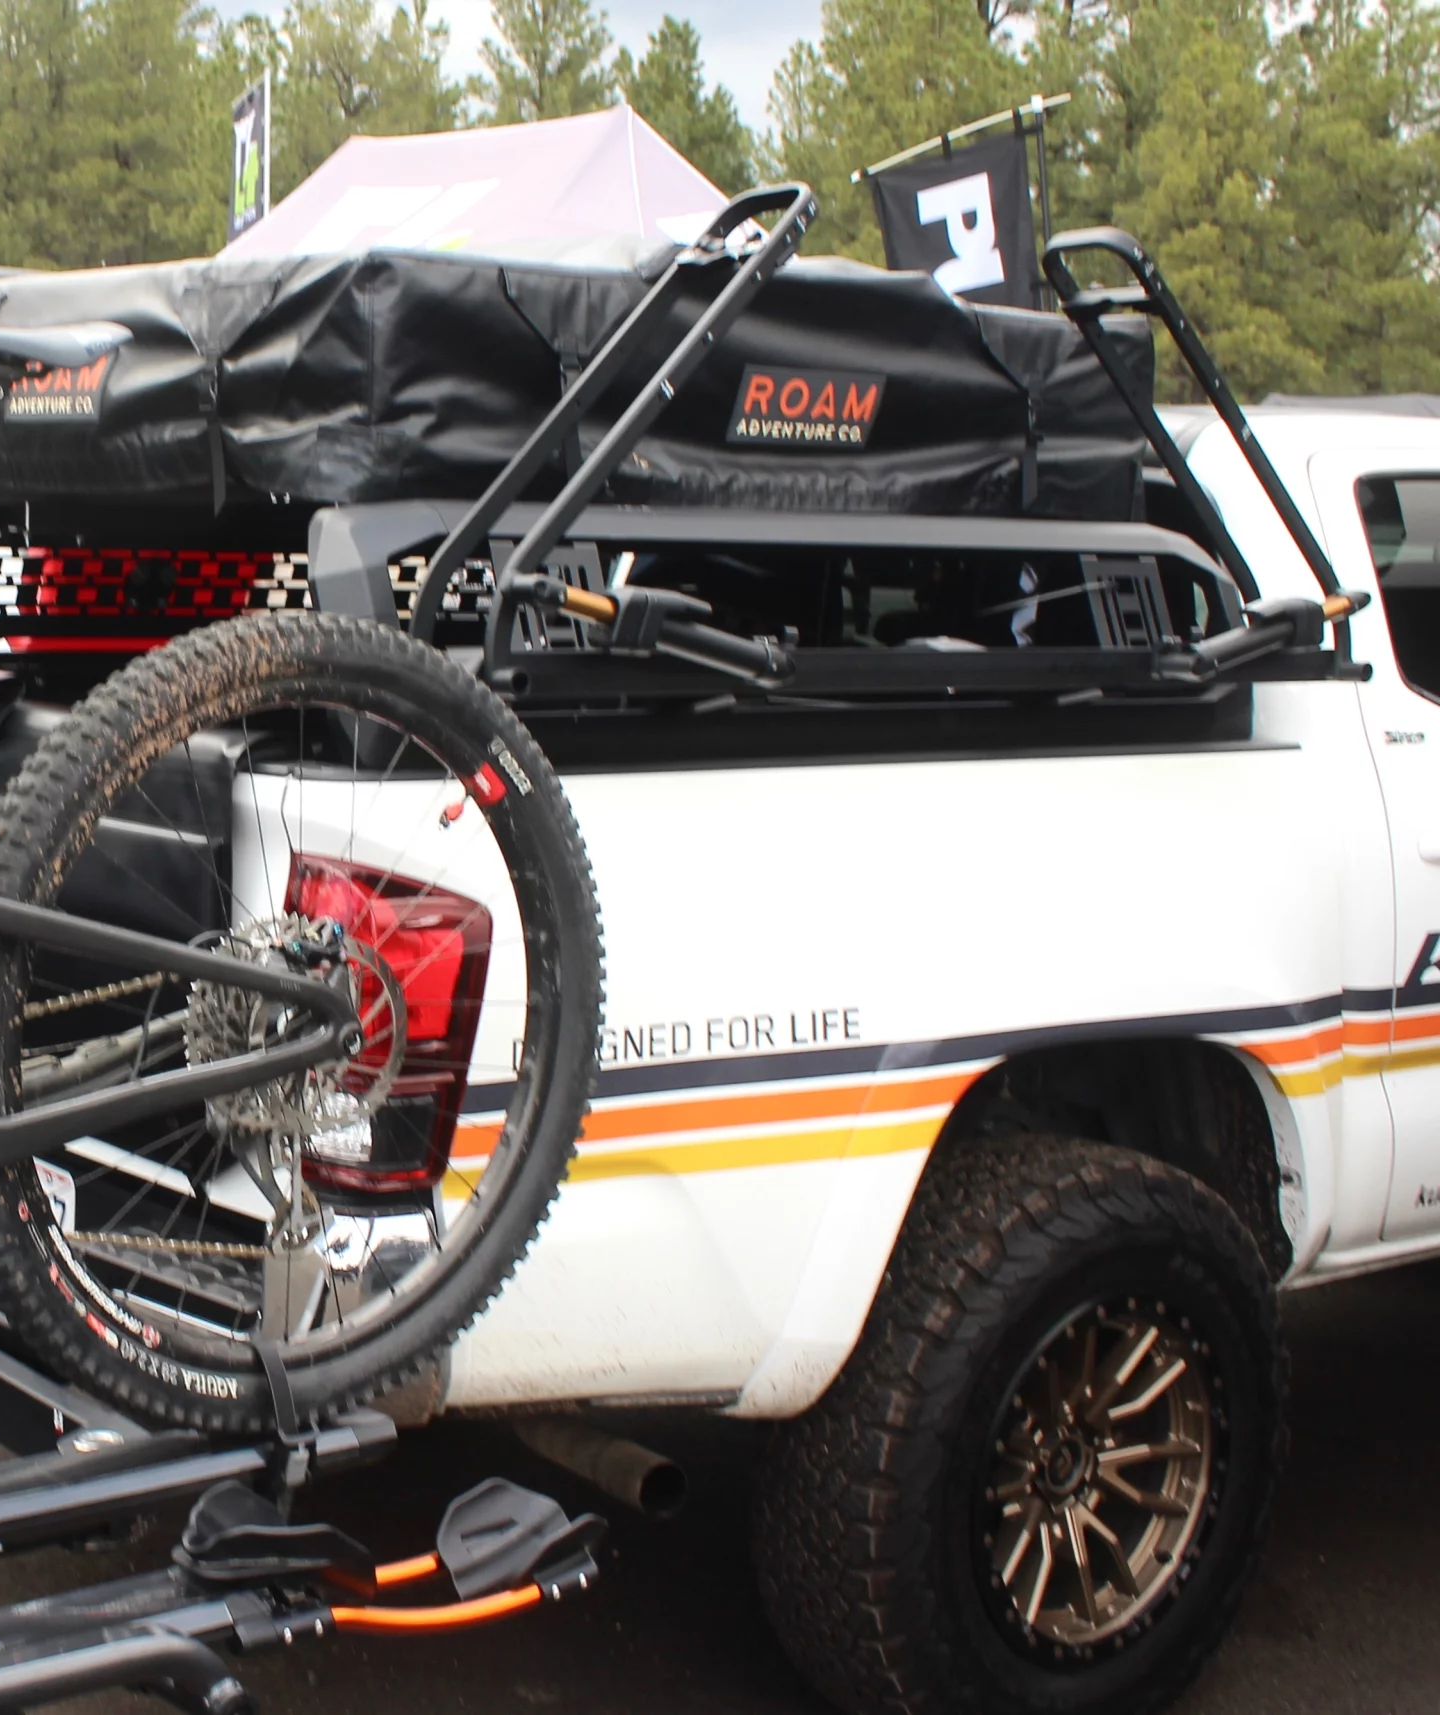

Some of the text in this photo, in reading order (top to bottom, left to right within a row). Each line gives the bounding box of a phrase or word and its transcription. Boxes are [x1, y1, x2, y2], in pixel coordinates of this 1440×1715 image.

[9, 396, 71, 415] ADVENTURE
[743, 373, 878, 423] ROAM
[736, 417, 836, 442] ADVENTURE
[513, 1006, 860, 1072] DGNED FOR LIFE
[180, 1367, 238, 1400] AQUILA
